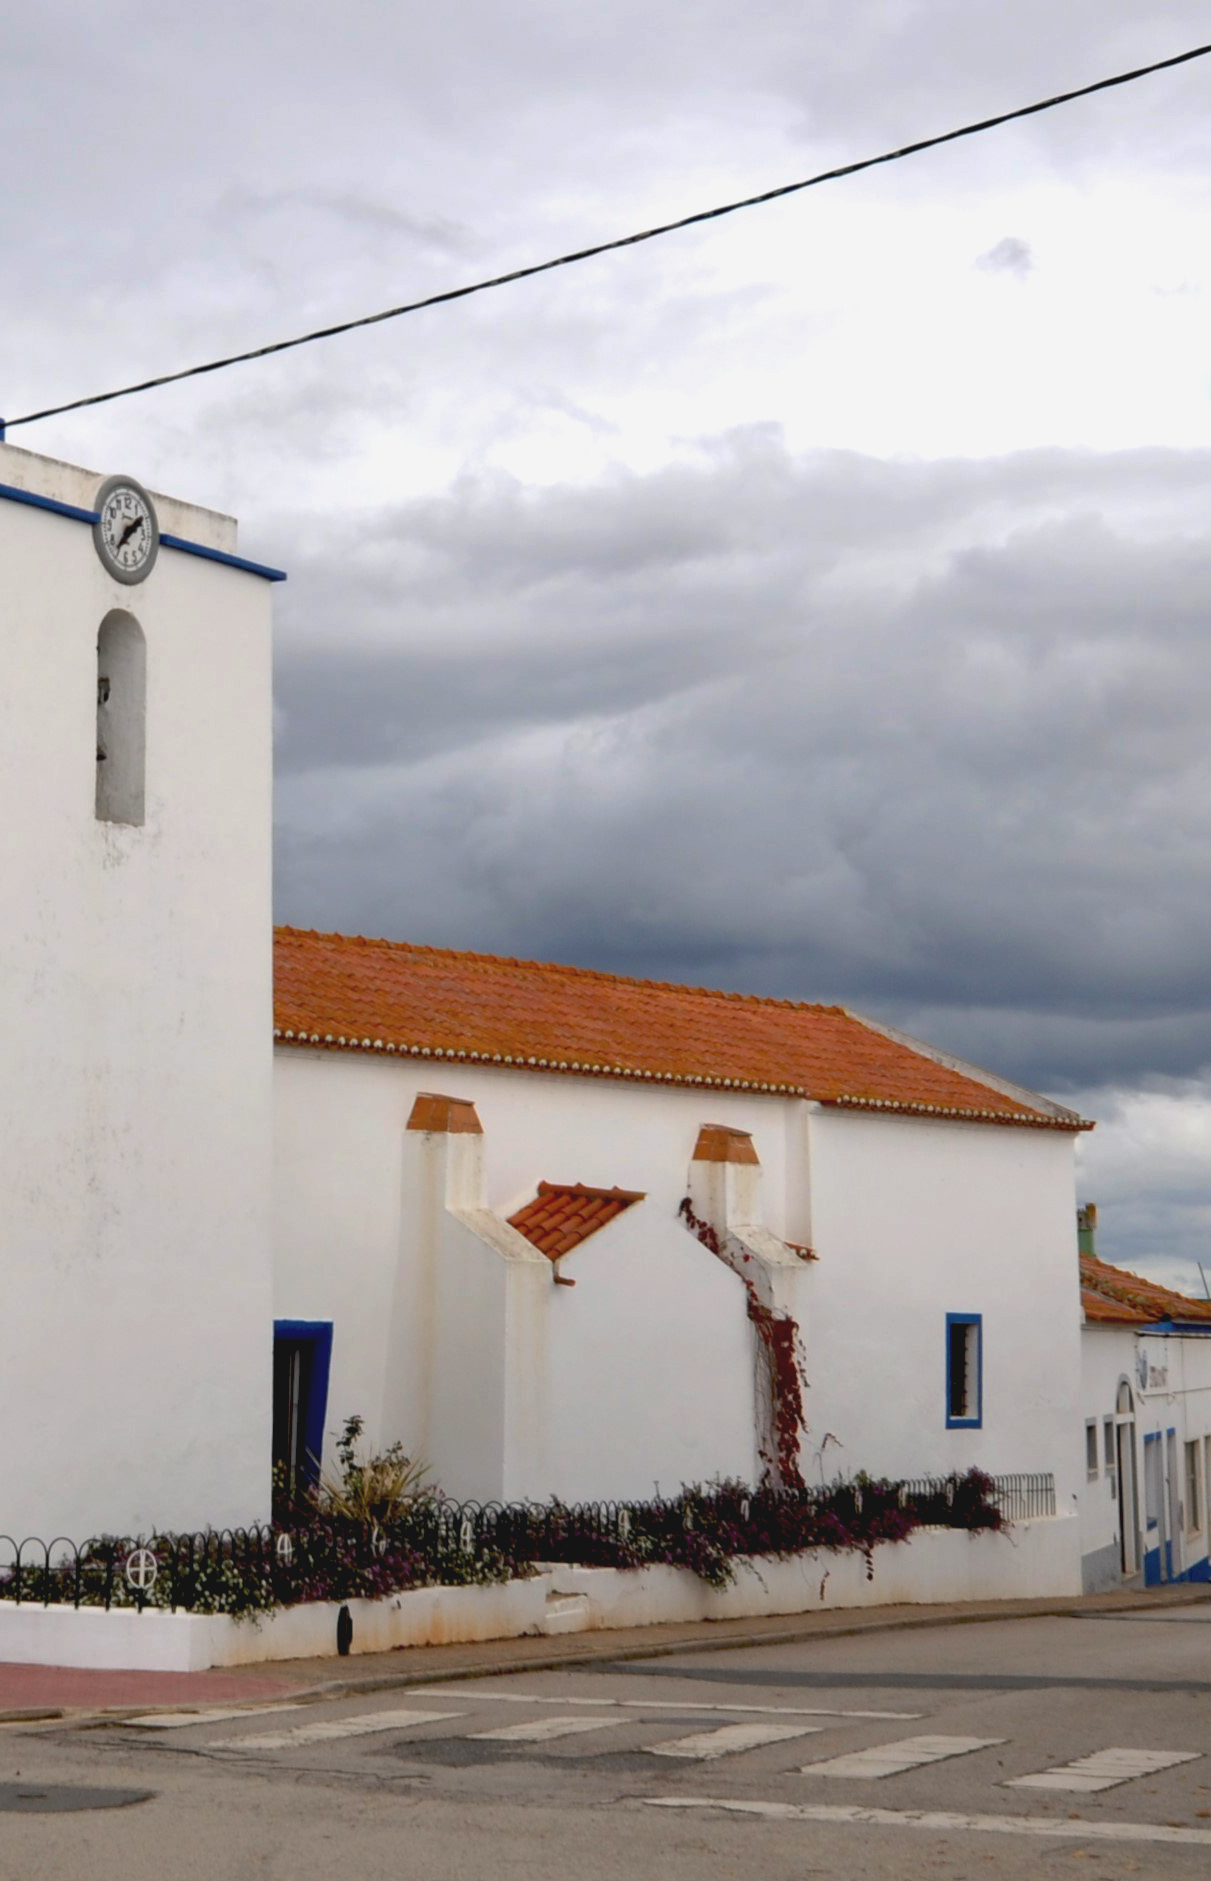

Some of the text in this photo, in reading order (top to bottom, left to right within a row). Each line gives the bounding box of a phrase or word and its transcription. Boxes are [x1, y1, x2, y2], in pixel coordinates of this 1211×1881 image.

[124, 496, 131, 510] 12
[107, 519, 112, 532] 9
[110, 533, 115, 546] 8
[141, 529, 146, 542] 3
[123, 551, 128, 563] 6
[132, 549, 137, 563] 5
